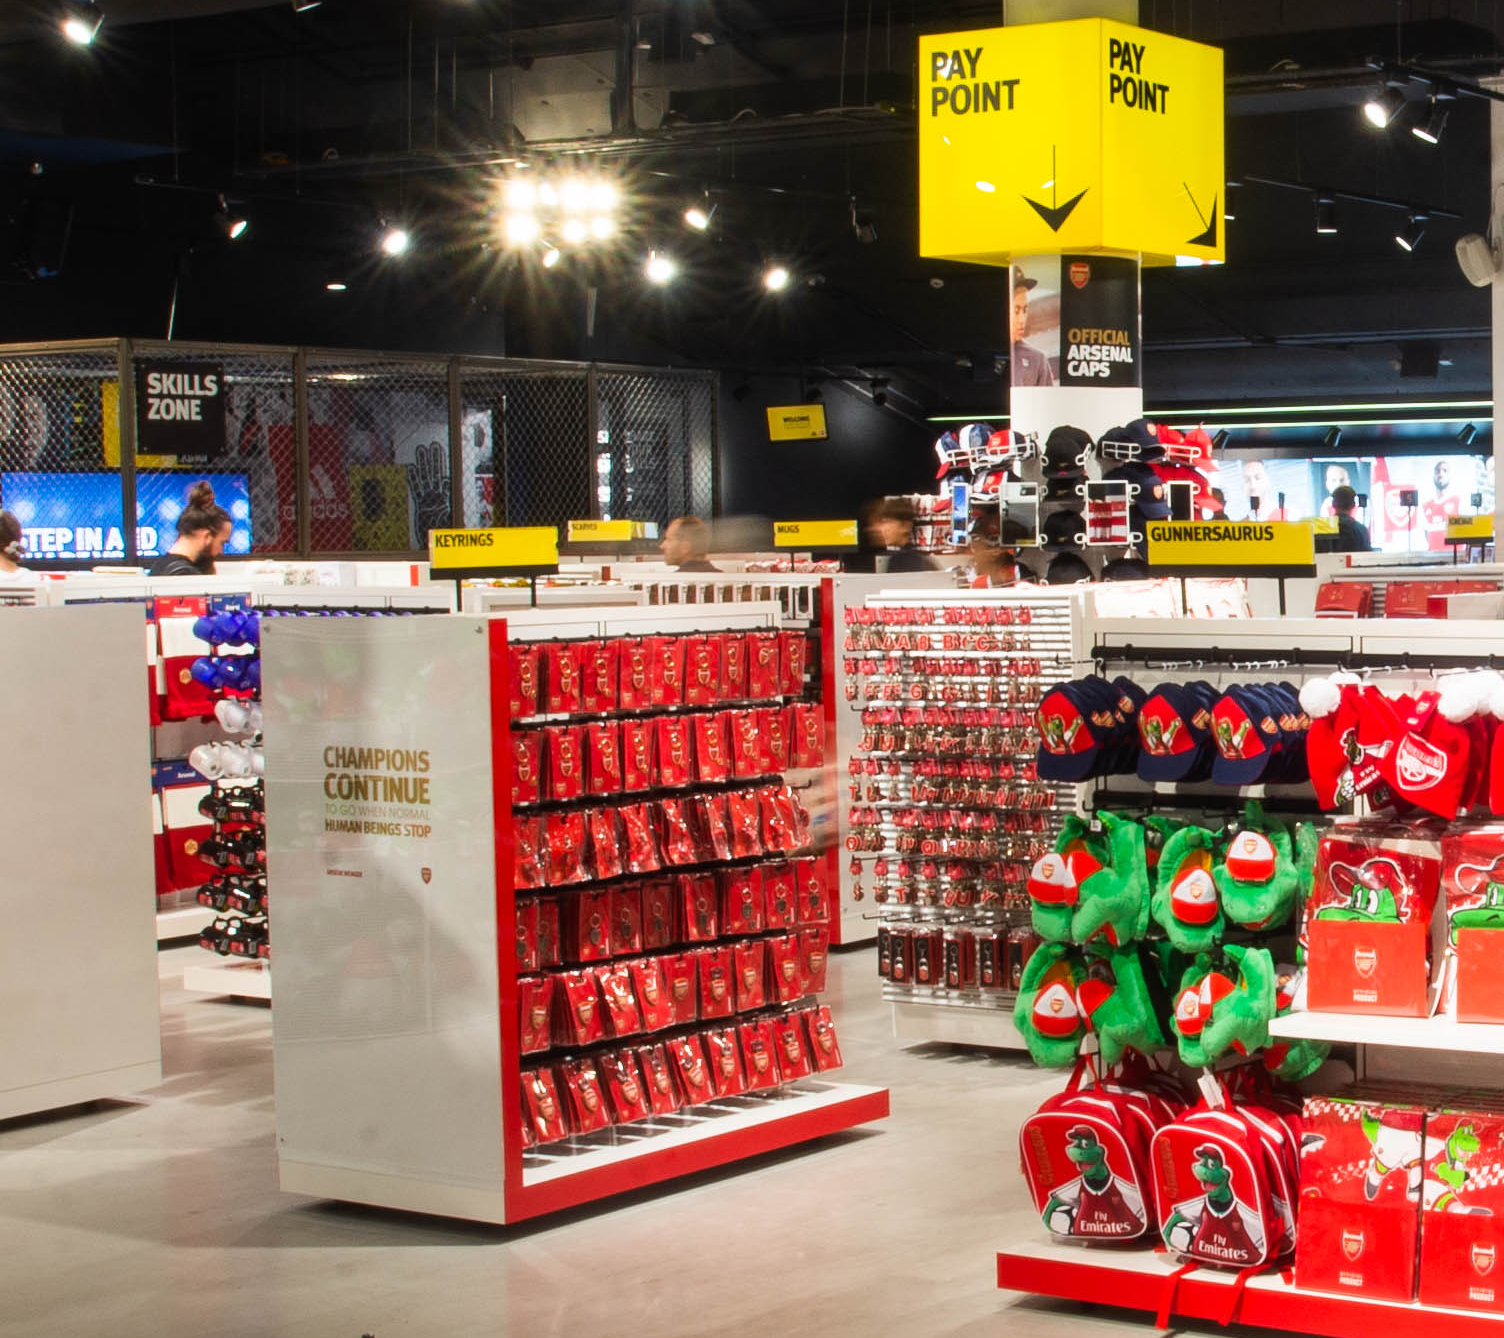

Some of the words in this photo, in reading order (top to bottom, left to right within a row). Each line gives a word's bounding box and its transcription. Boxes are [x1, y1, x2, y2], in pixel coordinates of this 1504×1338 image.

[929, 46, 984, 83] PAY
[1108, 36, 1146, 74] PAY
[930, 79, 1021, 118] POINT
[1108, 72, 1170, 115] POINT
[1067, 327, 1130, 346] OFFICIAL
[1067, 344, 1134, 364] ARSENAL
[1067, 361, 1111, 379] CAPS
[146, 372, 219, 397] SKILLS
[147, 397, 203, 422] ZONE
[777, 524, 800, 534] MUGS
[1150, 524, 1275, 544] GUNNERSAURUS
[75, 527, 102, 552] IN
[106, 527, 125, 552] A
[434, 532, 495, 548] KEYRINGS
[323, 745, 430, 773] CHAMPIONS
[323, 772, 431, 805] CONTINUE
[325, 803, 339, 814] TO
[340, 803, 357, 816] GO
[358, 805, 388, 818] WHEN
[389, 807, 430, 820] NORMAL
[325, 819, 363, 834] HUMAN
[363, 820, 403, 837] BEINGS
[403, 824, 432, 839] STOP
[1079, 1219, 1132, 1234] Emirates
[1094, 1210, 1108, 1223] Fly
[1213, 1233, 1227, 1245] Fly
[1197, 1240, 1249, 1261] Emirates
